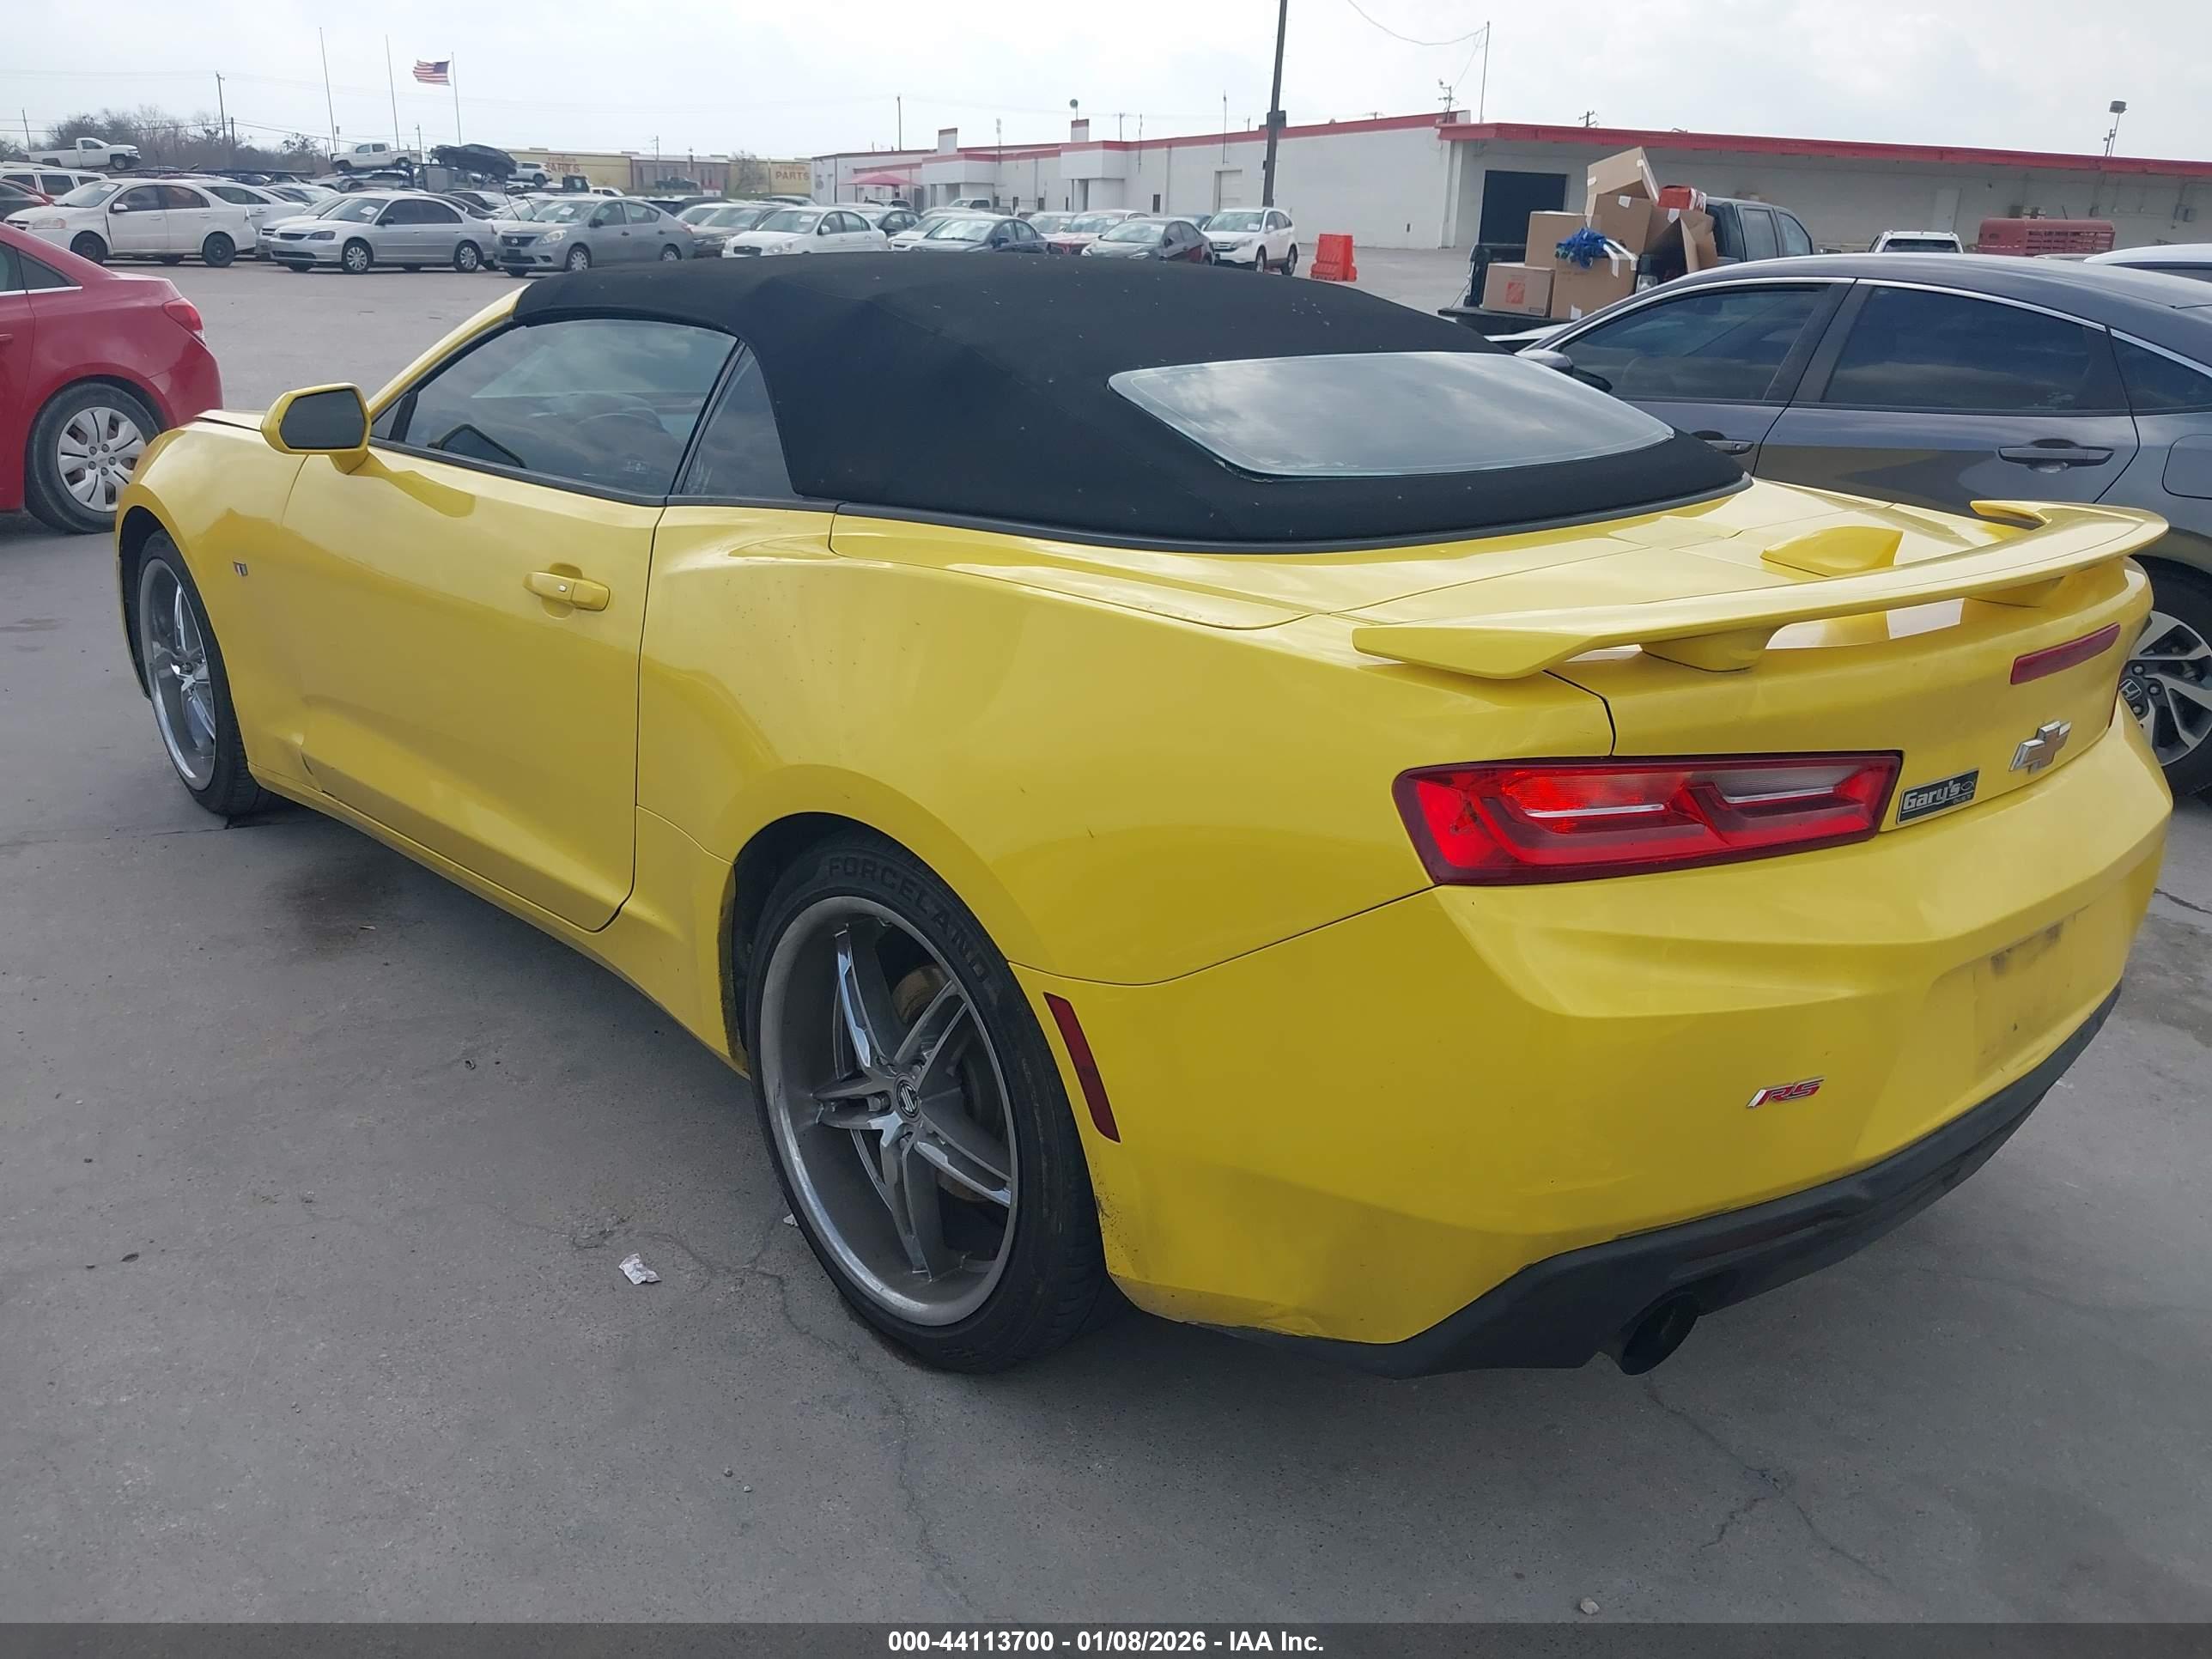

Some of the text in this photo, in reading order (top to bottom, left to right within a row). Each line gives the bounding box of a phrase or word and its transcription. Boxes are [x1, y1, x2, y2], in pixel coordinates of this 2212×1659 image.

[775, 171, 810, 180] PARTS
[1903, 780, 1961, 810] Gary's
[828, 856, 989, 983] FORCELAND
[1746, 1076, 1826, 1109] RS
